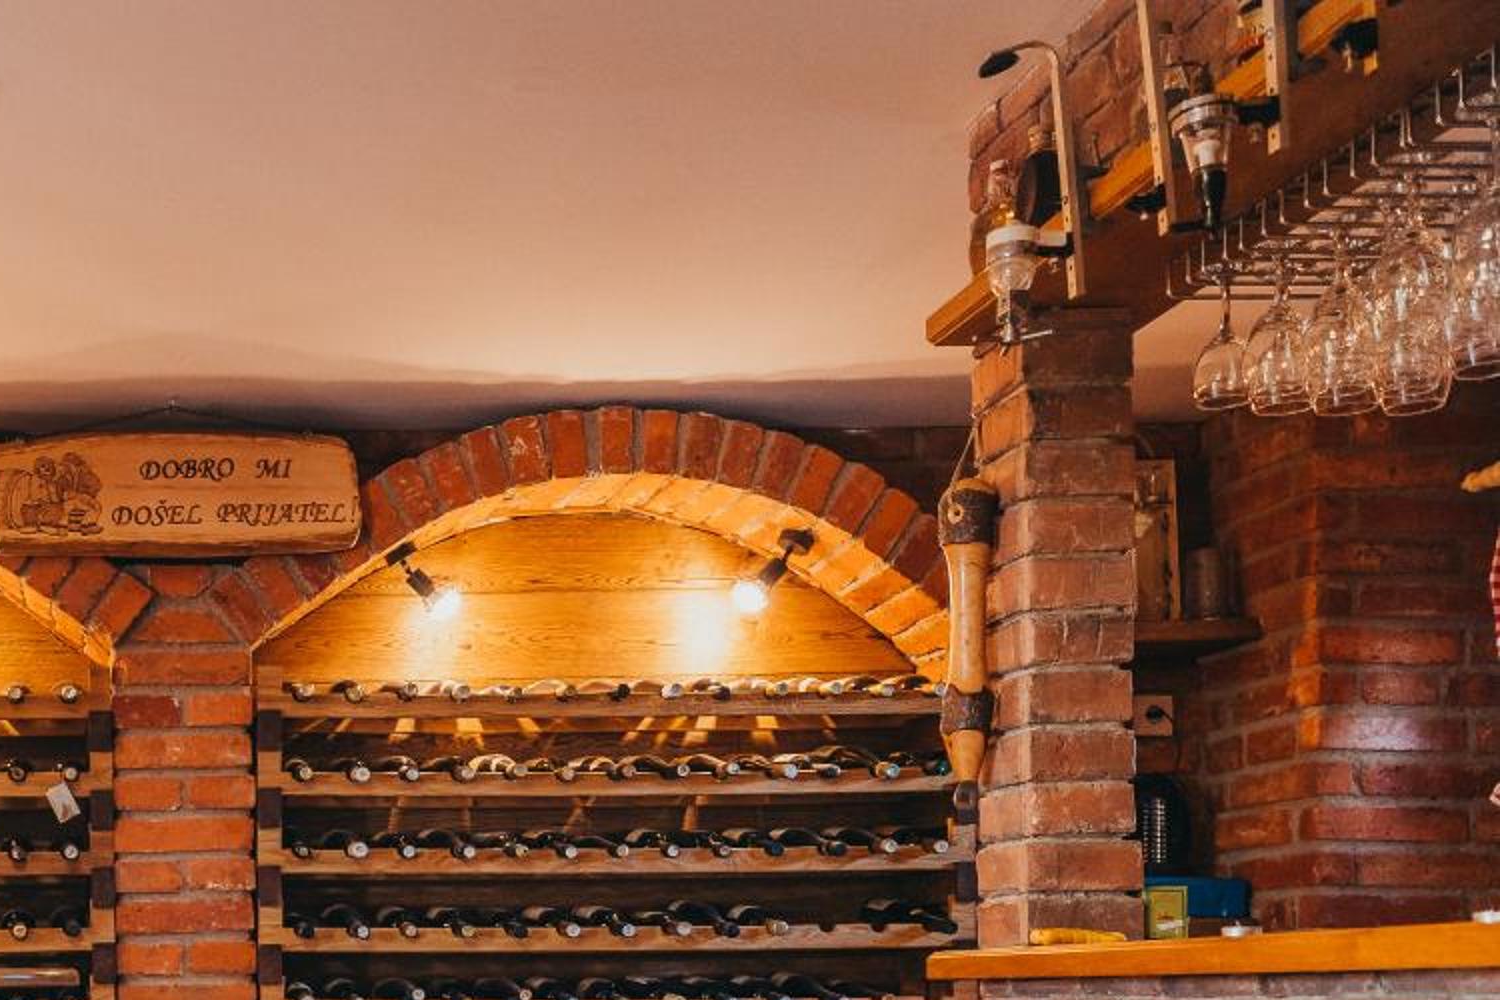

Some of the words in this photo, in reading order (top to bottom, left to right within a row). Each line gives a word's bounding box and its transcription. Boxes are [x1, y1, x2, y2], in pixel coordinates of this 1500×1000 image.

[139, 457, 235, 482] DOBRO
[255, 457, 293, 479] MI
[111, 499, 203, 526] DOŠEL
